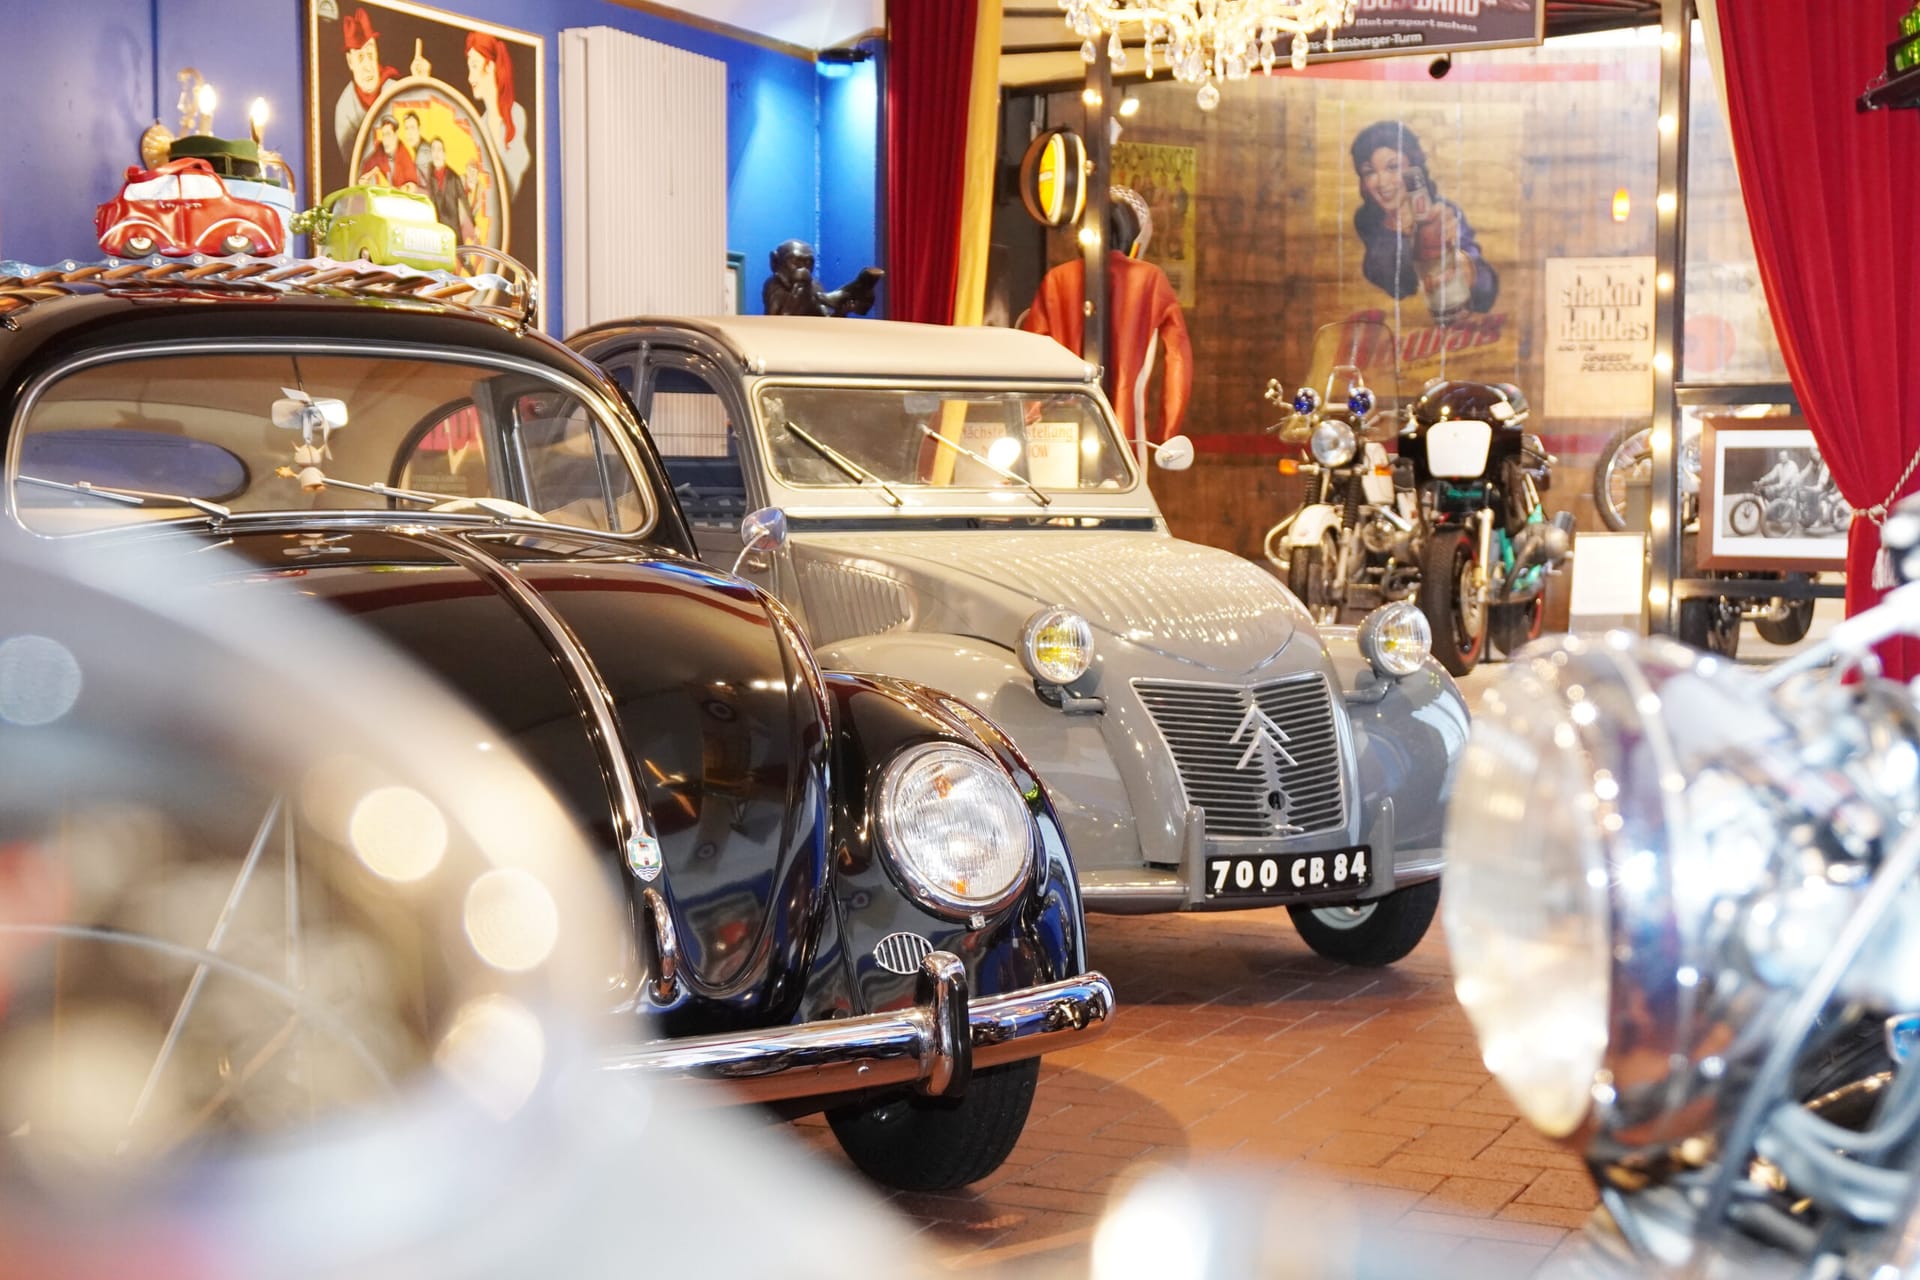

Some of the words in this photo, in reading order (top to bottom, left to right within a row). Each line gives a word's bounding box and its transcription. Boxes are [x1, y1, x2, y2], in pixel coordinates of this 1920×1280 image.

[1580, 362, 1649, 373] PEACOCKS
[1211, 859, 1279, 889] 700
[1291, 857, 1325, 887] CB
[1333, 851, 1367, 882] 84
